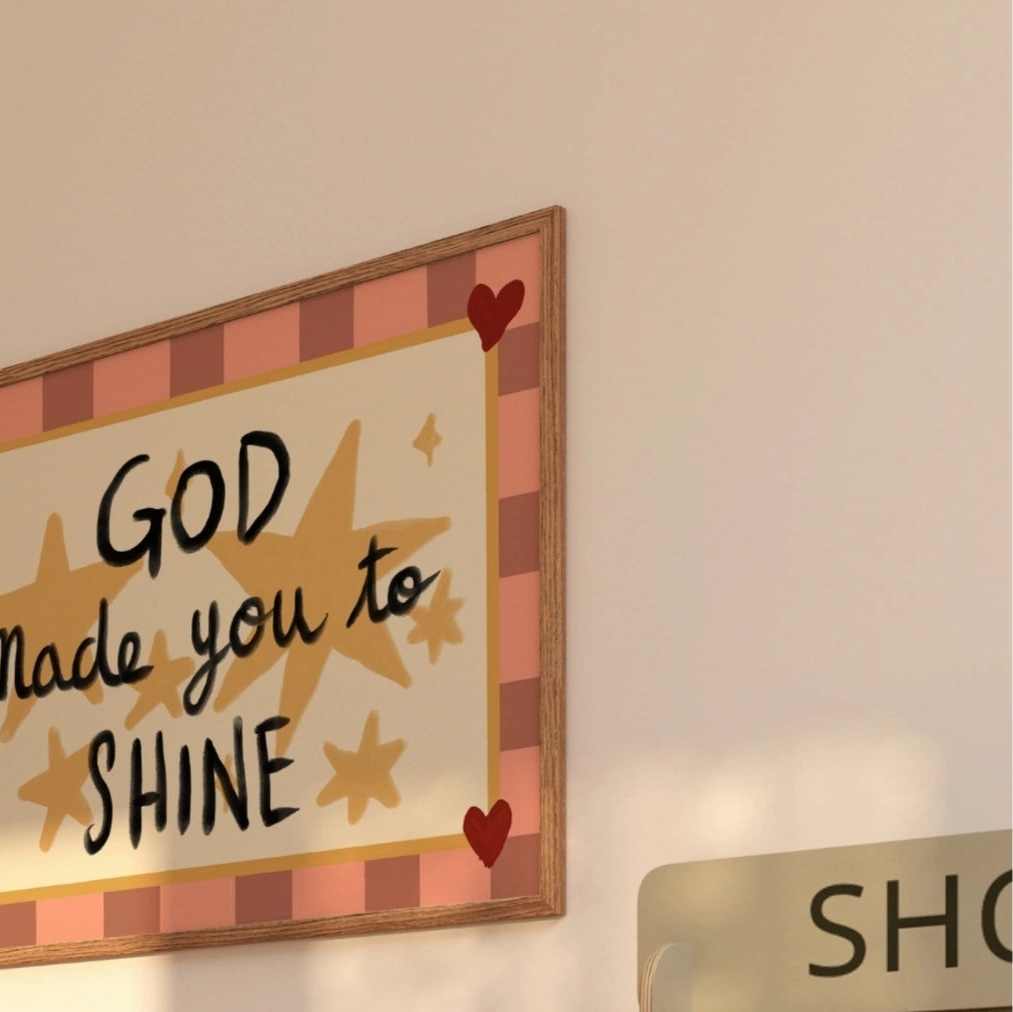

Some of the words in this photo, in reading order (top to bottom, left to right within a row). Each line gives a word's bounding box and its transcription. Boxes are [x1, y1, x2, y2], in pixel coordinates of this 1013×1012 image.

[96, 430, 291, 579] GOD
[182, 586, 329, 716] you
[345, 535, 442, 629] to
[83, 715, 301, 856] SHINE
